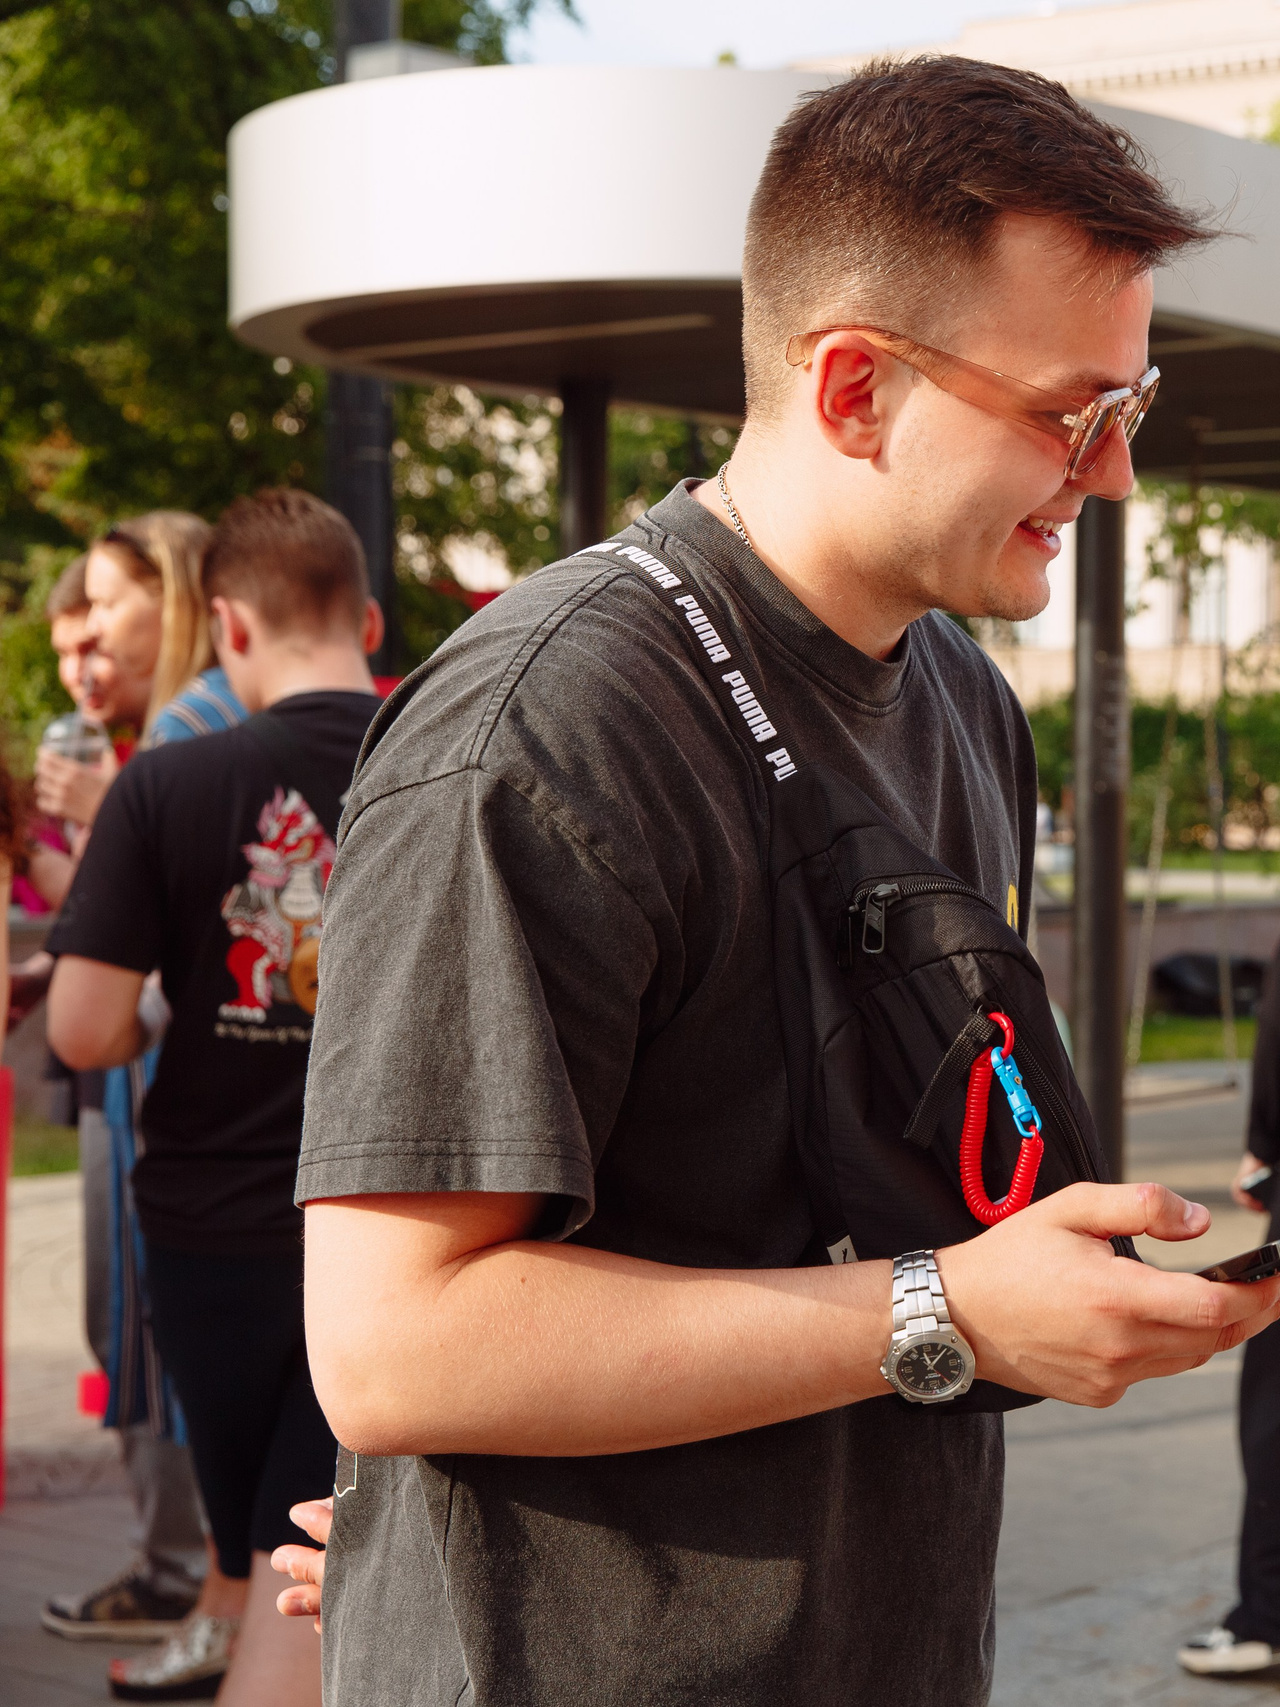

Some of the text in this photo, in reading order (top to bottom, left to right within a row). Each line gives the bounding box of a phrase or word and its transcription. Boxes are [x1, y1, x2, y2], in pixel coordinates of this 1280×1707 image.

[616, 546, 682, 589] PUMA
[675, 594, 731, 663] PUMA
[721, 670, 778, 743] PUMA
